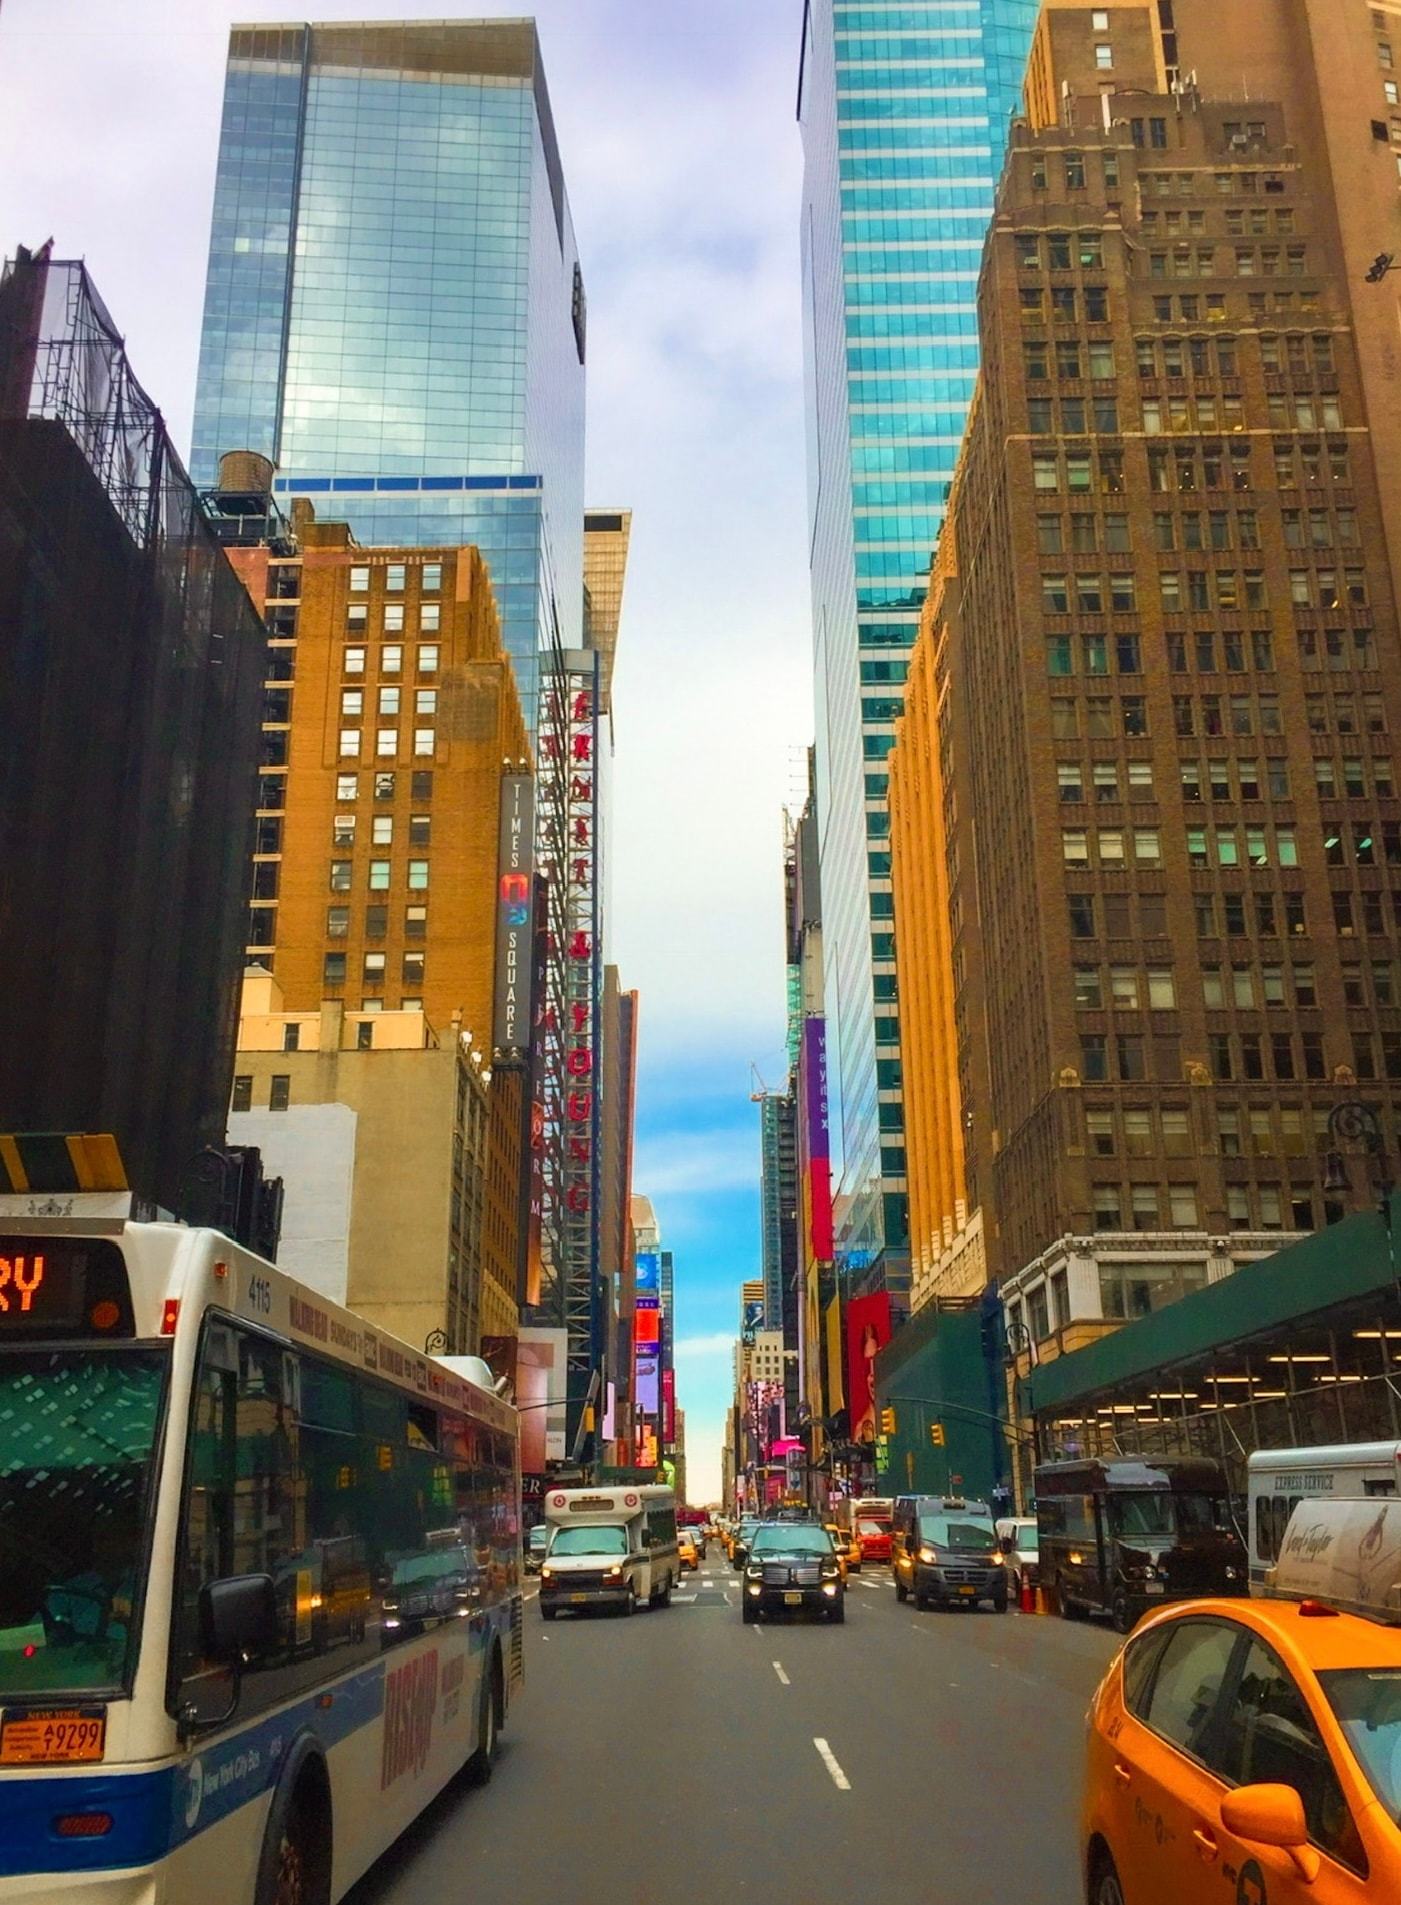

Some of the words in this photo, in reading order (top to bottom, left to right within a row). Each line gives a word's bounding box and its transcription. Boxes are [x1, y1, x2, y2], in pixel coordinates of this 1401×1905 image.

[510, 784, 522, 868] TIMES
[506, 931, 518, 1041] SQUARE
[567, 1003, 593, 1212] YOUNG
[248, 1274, 271, 1315] 4115
[1274, 1475, 1302, 1491] EXPRESS
[1303, 1473, 1334, 1490] SERVICE
